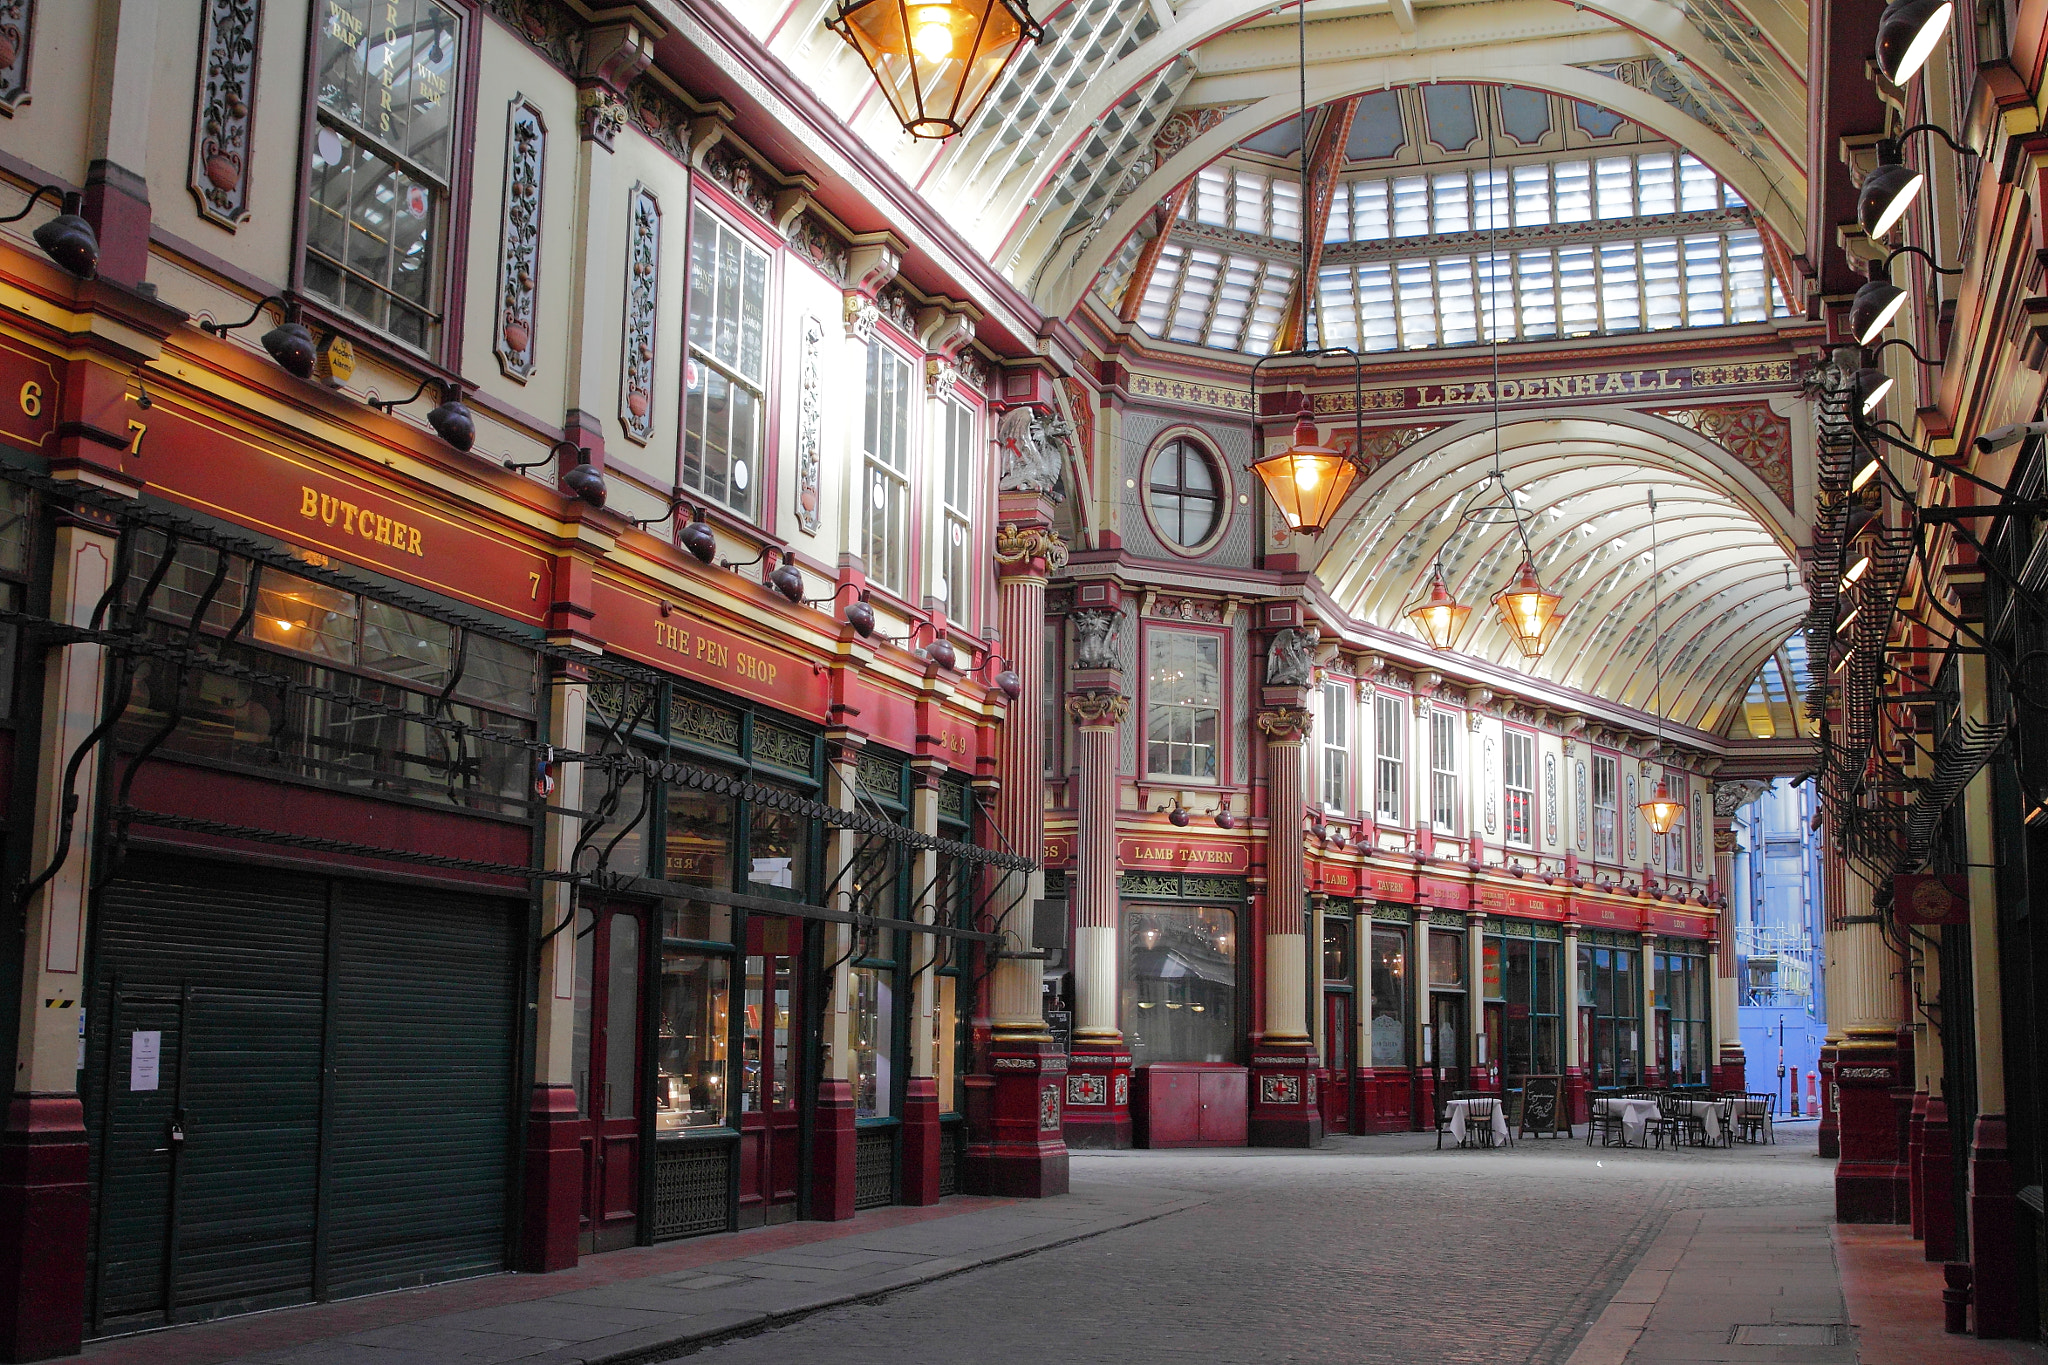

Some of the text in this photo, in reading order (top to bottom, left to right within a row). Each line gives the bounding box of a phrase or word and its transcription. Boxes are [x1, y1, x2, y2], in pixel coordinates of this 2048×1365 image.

[330, 1, 362, 36] WINE
[332, 22, 357, 50] BAR
[381, 0, 399, 132] ROKERS
[417, 62, 447, 94] WINE
[420, 82, 441, 107] BAR
[693, 263, 713, 286] WINE
[723, 241, 735, 357] BROKERS
[744, 299, 762, 319] WINE
[332, 344, 354, 361] Modern
[332, 357, 352, 372] Alarms
[20, 380, 42, 418] 6
[1417, 370, 1681, 407] LEADENHALL
[128, 418, 146, 457] 7
[300, 486, 423, 557] BUTCHER
[529, 572, 541, 600] 7
[654, 620, 777, 685] THE PEN SHOP
[960, 737, 967, 754] 9
[1135, 846, 1233, 864] LAMB TAVERN
[1326, 873, 1349, 886] LAMB
[1377, 880, 1404, 893] TAVERN
[1529, 900, 1545, 910] LEON
[1601, 910, 1615, 919] LEON
